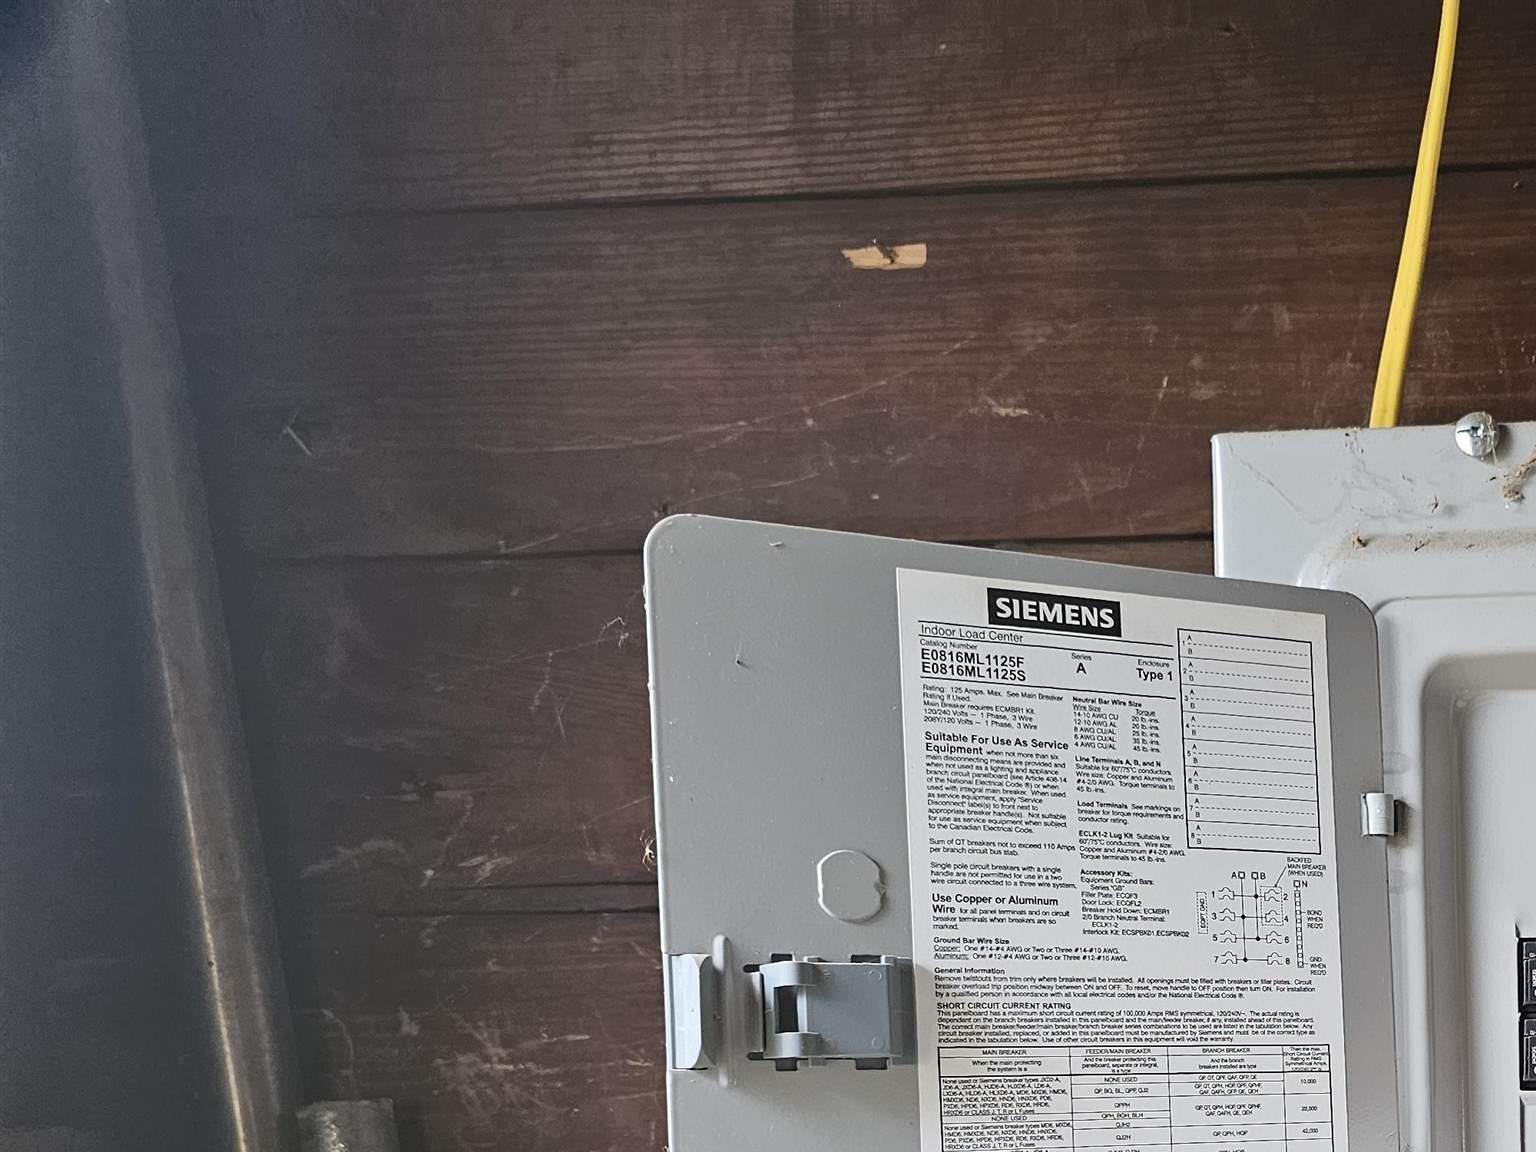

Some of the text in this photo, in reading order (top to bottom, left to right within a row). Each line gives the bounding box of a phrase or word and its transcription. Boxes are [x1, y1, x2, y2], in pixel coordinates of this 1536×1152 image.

[996, 597, 1114, 628] SIEMENS
[921, 624, 1023, 642] Indoor Load Center
[919, 638, 977, 650] Catalog Number
[921, 647, 1024, 668] E0816ML1125F
[1071, 652, 1091, 660] Series
[1076, 662, 1086, 674] A
[1137, 658, 1169, 668] Enclosure
[921, 661, 1025, 681] E0816ML1125S
[1135, 667, 1172, 681] Type 1
[924, 730, 1068, 750] Suitable For Use As Service
[925, 742, 982, 755] Equipment
[1095, 801, 1128, 809] Terminals
[1078, 829, 1107, 837] ECLK1-2
[1109, 831, 1122, 839] Lug
[1080, 868, 1115, 877] Accessory
[932, 893, 1058, 905] Use Copper or Aluminum
[1211, 890, 1214, 898] 1
[932, 903, 955, 913] Wire
[1211, 912, 1217, 920] 3
[1212, 933, 1217, 941] 5
[1284, 935, 1289, 943] 6
[1214, 955, 1218, 963] 7
[1285, 957, 1290, 965] 8
[934, 966, 962, 975] General
[936, 1001, 965, 1010] SHORT
